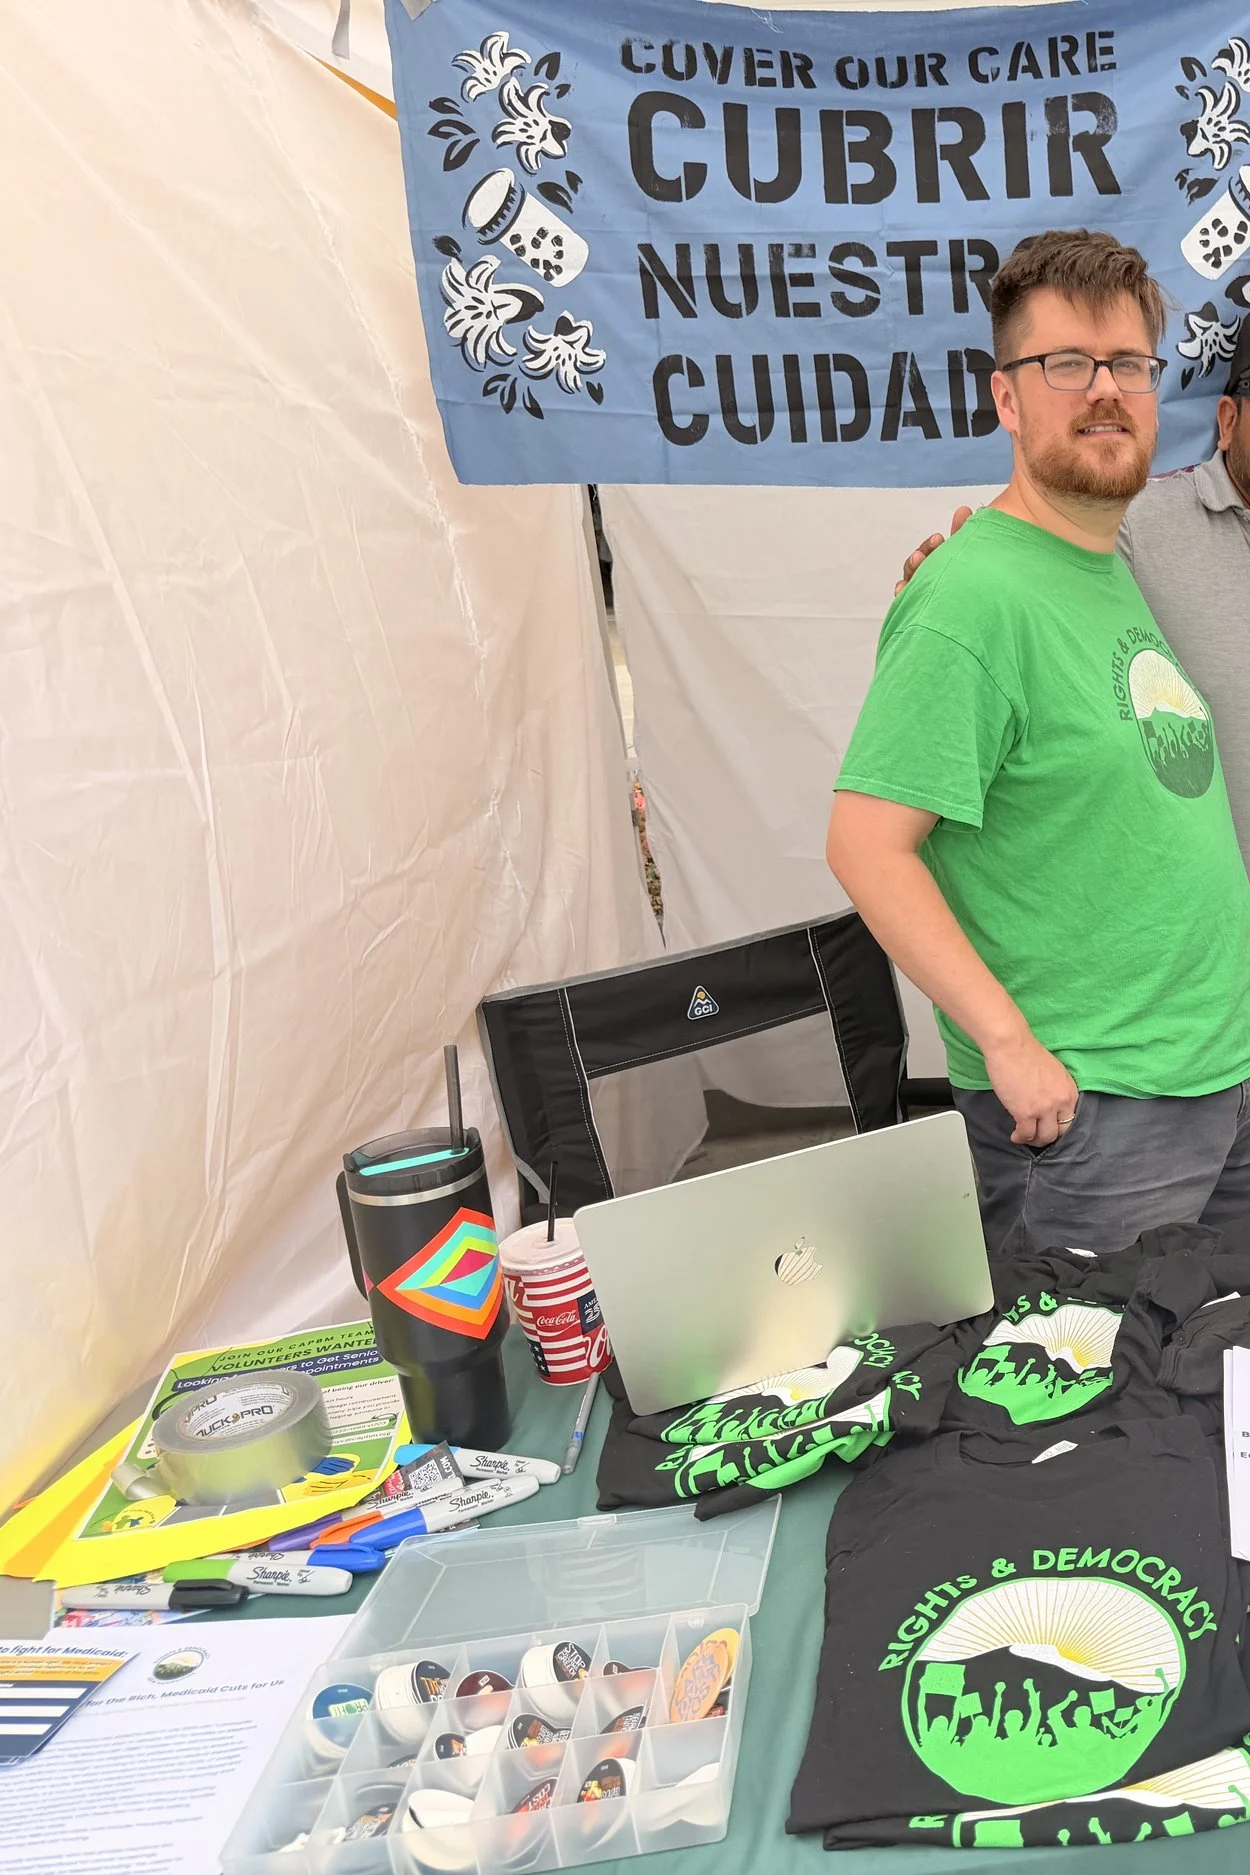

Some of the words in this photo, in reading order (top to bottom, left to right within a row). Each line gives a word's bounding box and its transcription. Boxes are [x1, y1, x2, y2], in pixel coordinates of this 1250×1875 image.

[620, 37, 817, 90] COVER
[834, 52, 948, 90] OUR
[968, 31, 1117, 84] CARE
[627, 91, 1122, 204] CUBRIR
[637, 239, 1006, 319] NUESTR
[653, 347, 1001, 446] CUIDAD
[1117, 638, 1131, 655] &
[1111, 651, 1133, 721] RIGHTS
[694, 1004, 713, 1016] GCI
[1039, 1292, 1058, 1311] &
[219, 1352, 251, 1362] JOIN
[257, 1347, 283, 1356] OUR
[340, 1329, 374, 1340] TEAM
[301, 1360, 314, 1368] to
[316, 1354, 341, 1366] Get
[342, 1350, 378, 1361] Senio
[212, 1348, 312, 1372] VOLUNTEERS
[301, 1356, 379, 1376] pointments
[240, 1405, 273, 1419] PRO
[878, 1575, 978, 1673] RIGHTS
[991, 1557, 1016, 1579] &
[1033, 1546, 1218, 1641] DEMOCRACY
[11, 1645, 45, 1657] fight
[46, 1646, 63, 1655] for
[64, 1646, 129, 1658] Medicaid:
[86, 1698, 104, 1708] for
[105, 1696, 128, 1706] the
[161, 1686, 219, 1698] Medicaid
[220, 1683, 249, 1694] Cuts
[250, 1681, 269, 1690] for
[270, 1678, 286, 1687] Us
